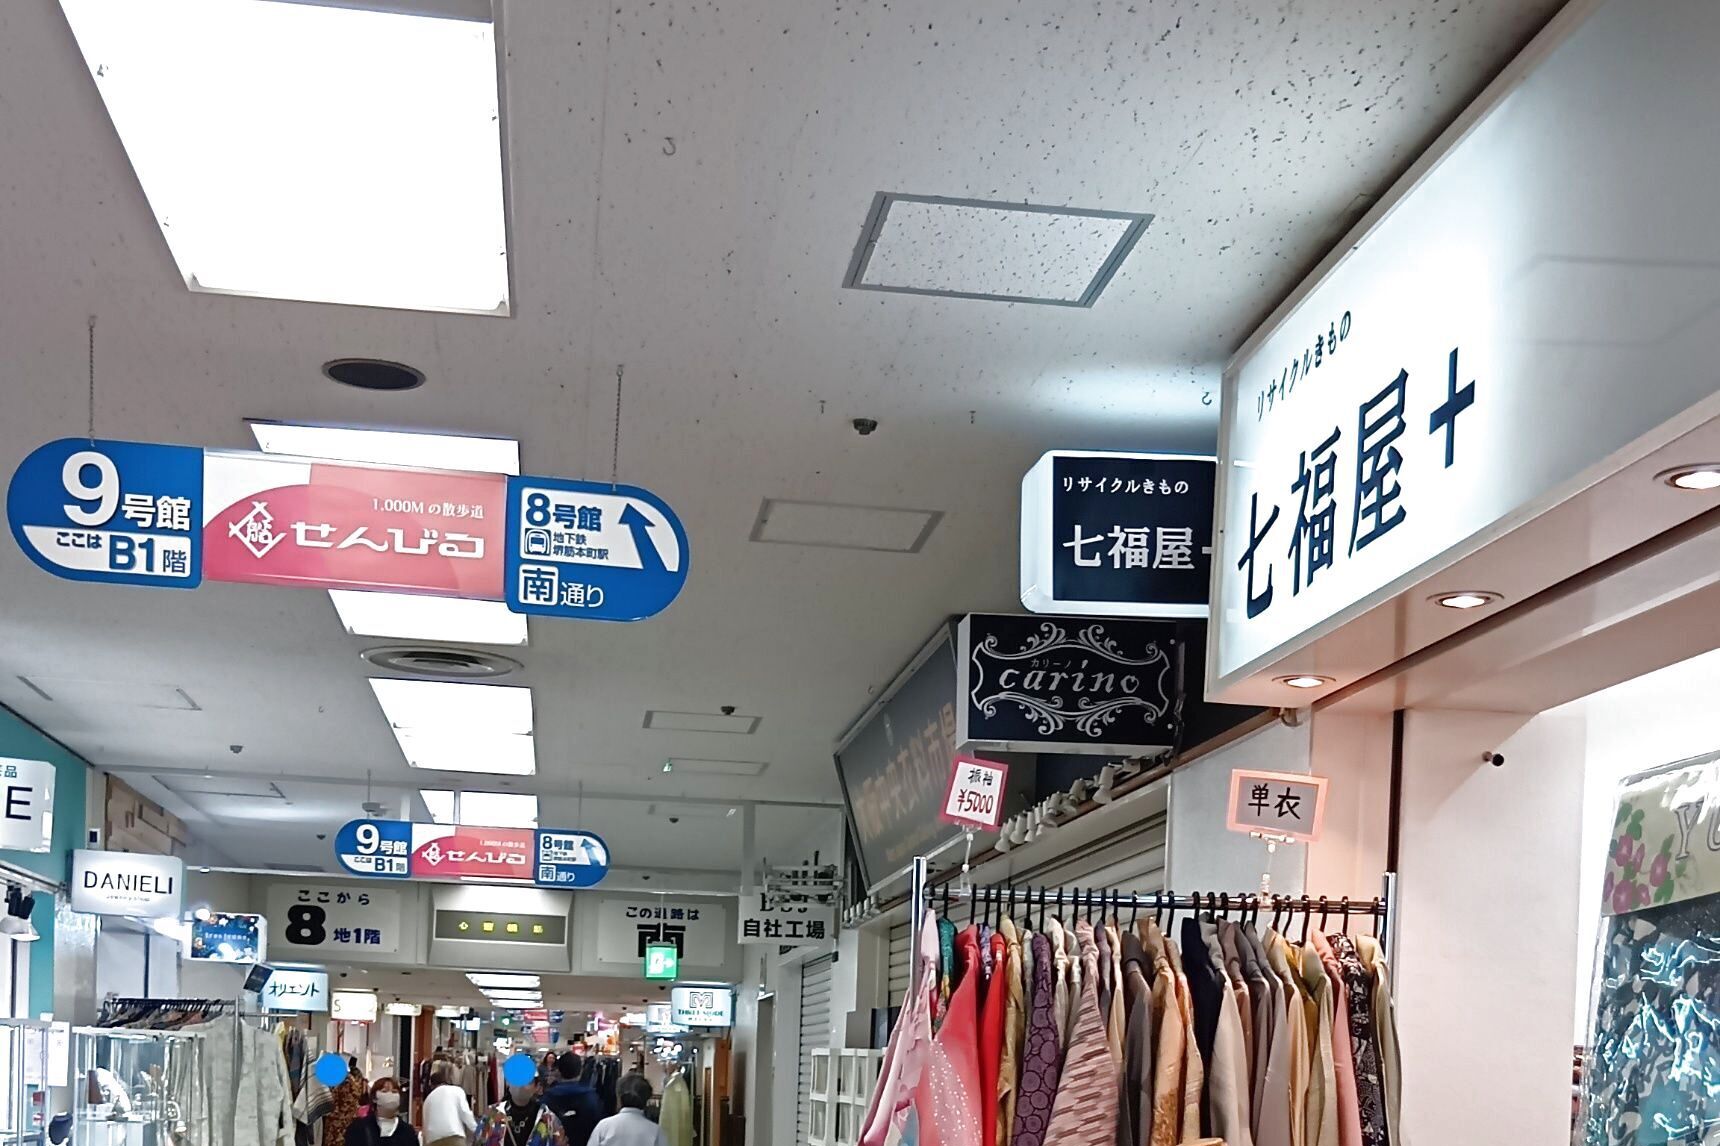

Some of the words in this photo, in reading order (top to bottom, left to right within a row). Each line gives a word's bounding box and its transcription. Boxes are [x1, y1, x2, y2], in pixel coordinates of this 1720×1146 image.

[1256, 309, 1352, 422] リサイクルきもの
[62, 451, 191, 531] 9号館
[1062, 476, 1190, 495] リサイクルきもの
[525, 492, 602, 532] 8号館
[56, 531, 103, 549] ここは
[109, 534, 187, 574] B1階
[290, 521, 485, 559] せんびる
[552, 545, 609, 560] 堺筋本町駅
[553, 531, 587, 546] 地下鉄
[1062, 524, 1213, 570] 七福屋
[998, 659, 1140, 694] carino
[1031, 658, 1071, 669] カリーノ
[1247, 782, 1301, 820] 単衣
[356, 824, 408, 855] 9号館
[84, 870, 173, 895] DANIELI
[298, 890, 370, 905] ここから
[744, 918, 825, 940] 自社工場
[269, 980, 320, 998] オリエント
